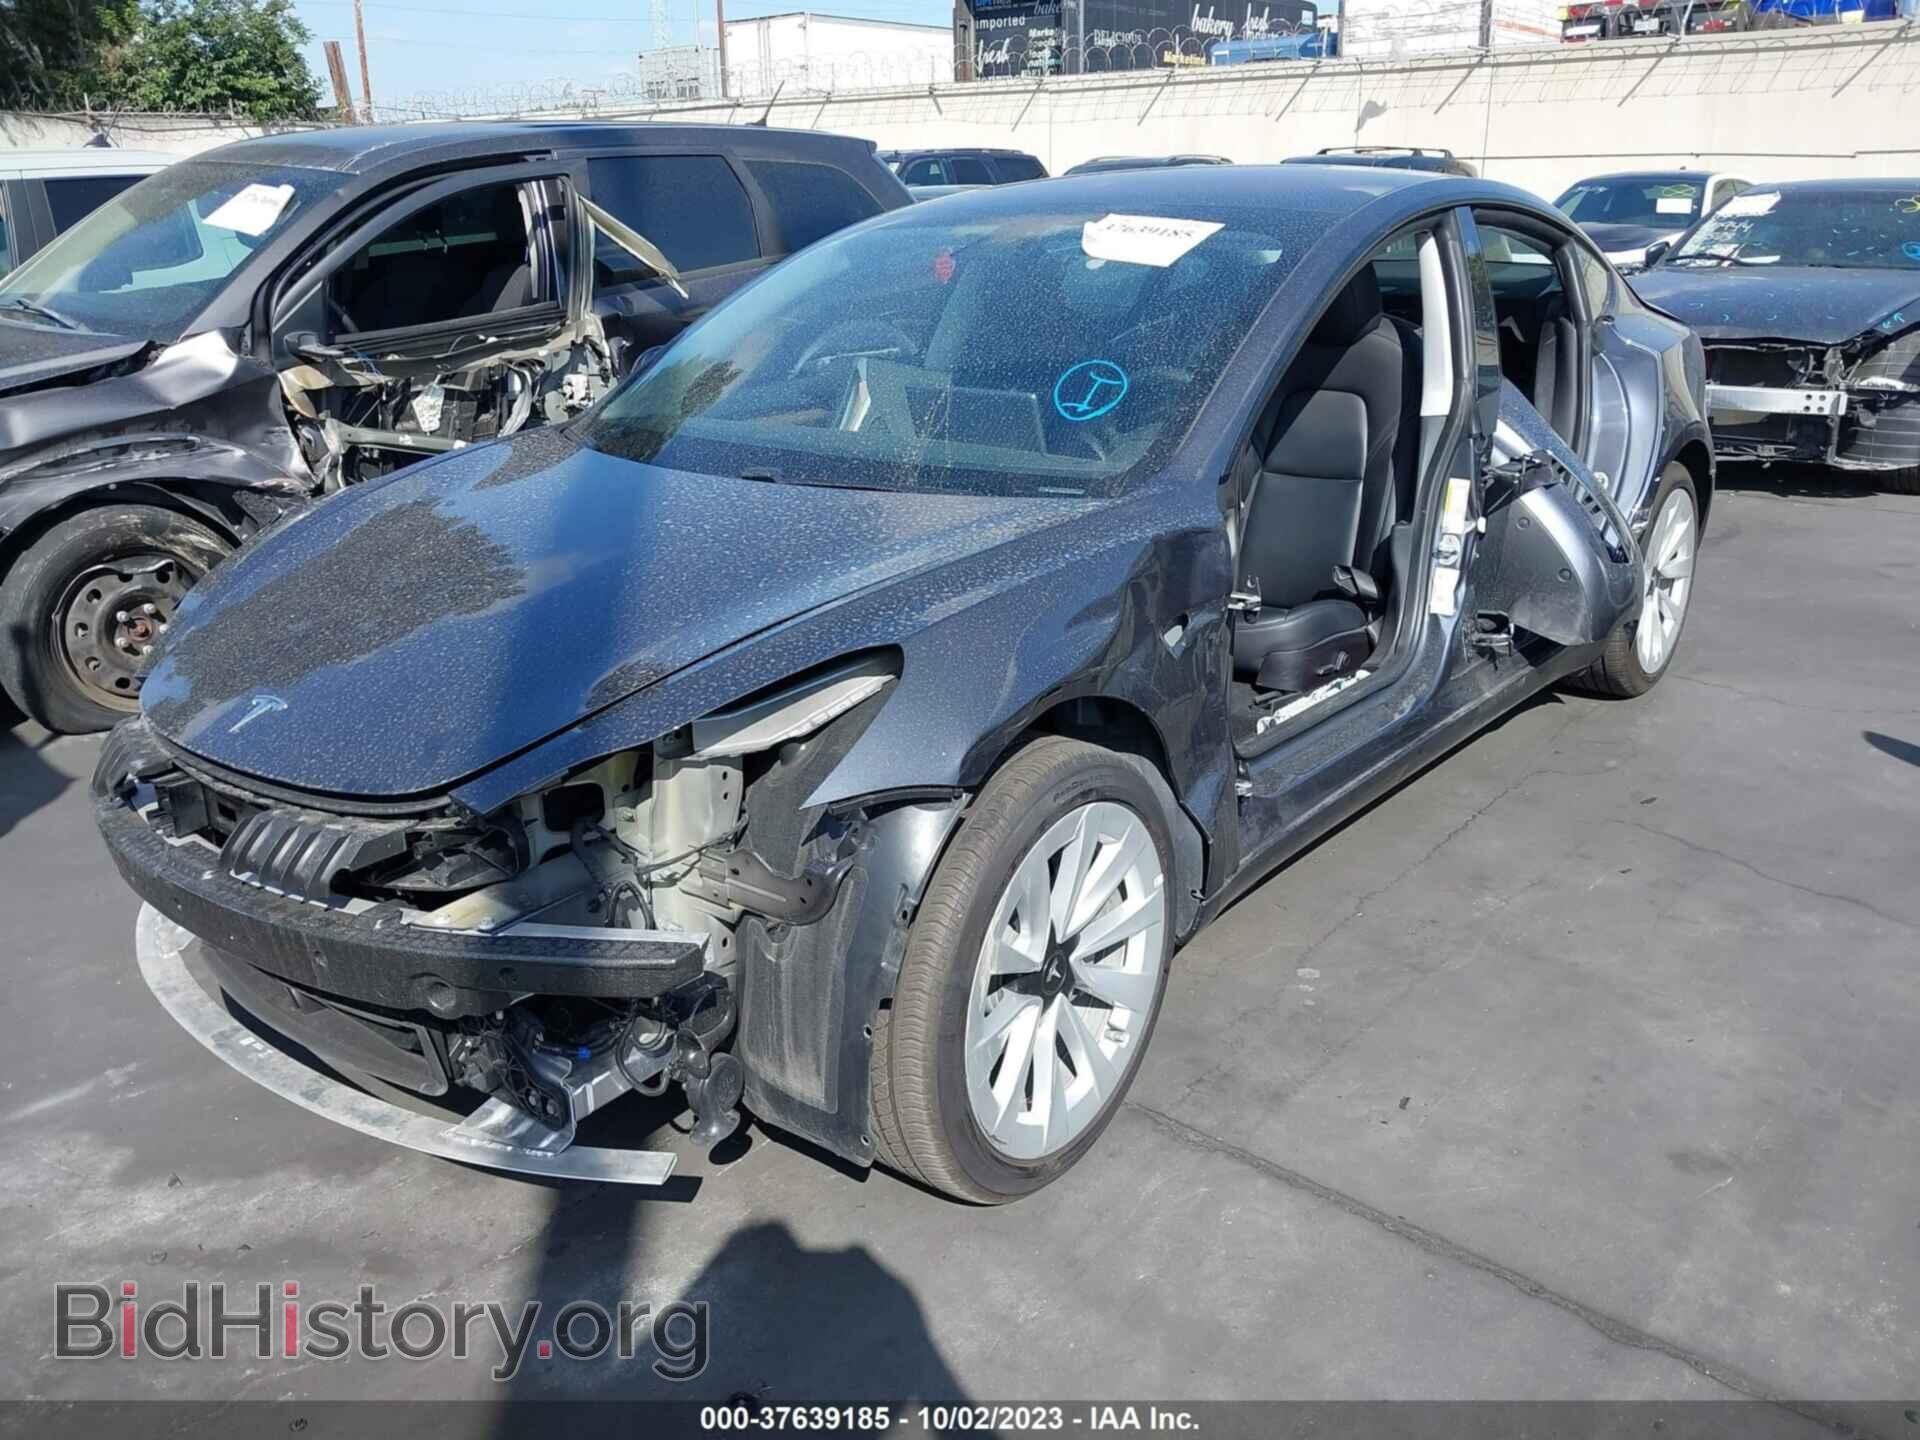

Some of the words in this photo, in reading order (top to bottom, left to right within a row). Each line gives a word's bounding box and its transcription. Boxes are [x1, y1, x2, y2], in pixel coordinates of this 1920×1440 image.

[976, 13, 1025, 31] imported
[1191, 3, 1234, 43] bakery
[976, 37, 1011, 73] fresh
